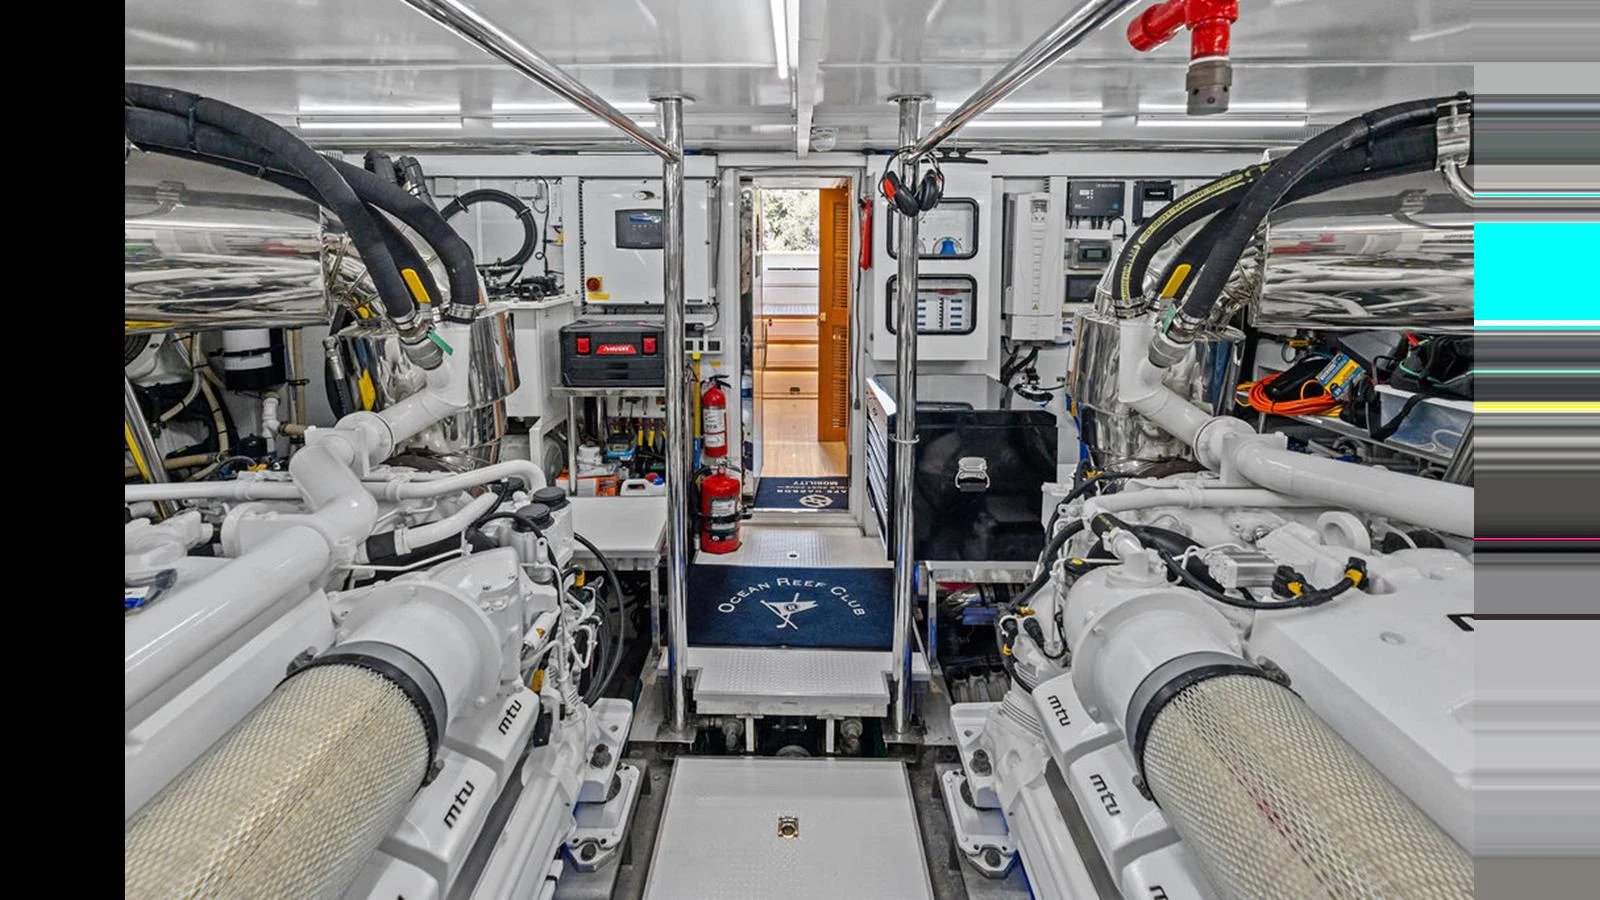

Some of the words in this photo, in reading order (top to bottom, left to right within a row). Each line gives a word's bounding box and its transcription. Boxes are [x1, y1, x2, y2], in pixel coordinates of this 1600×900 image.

[717, 582, 771, 613] OCEAN
[776, 577, 827, 588] REEF
[830, 586, 866, 616] CLUB
[497, 699, 523, 736] mtu
[1047, 694, 1071, 727] mtu
[443, 780, 476, 830] mtu
[1089, 773, 1121, 817] mtu
